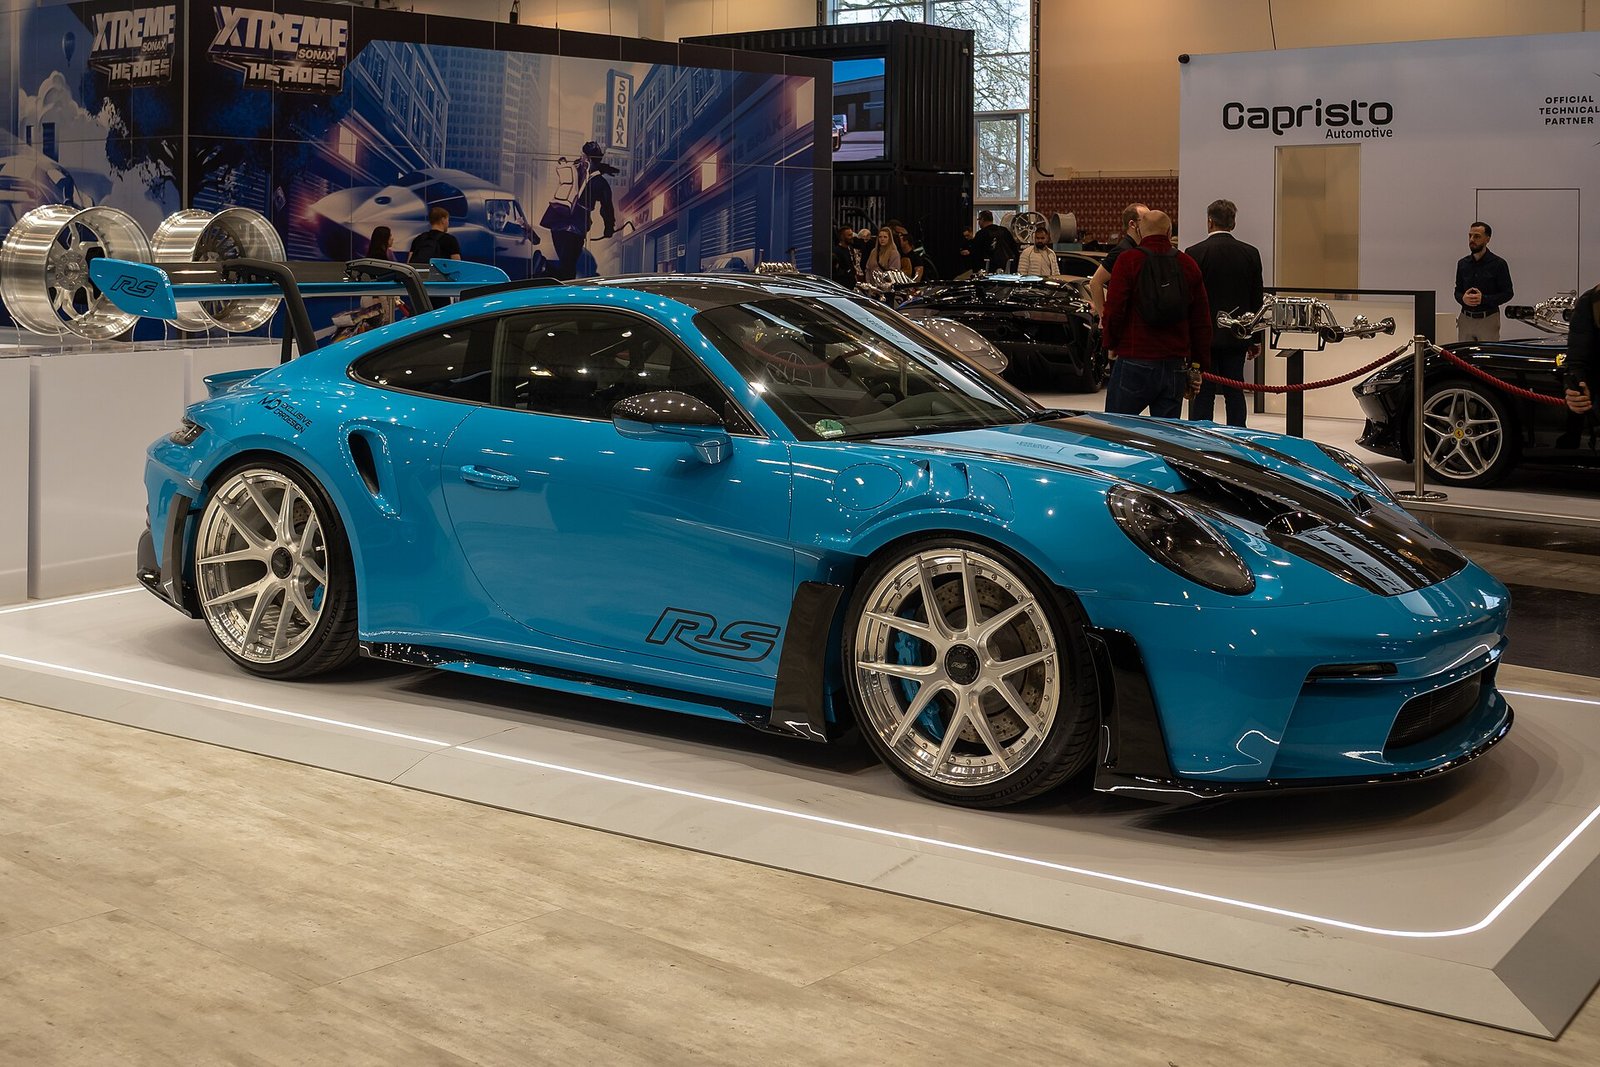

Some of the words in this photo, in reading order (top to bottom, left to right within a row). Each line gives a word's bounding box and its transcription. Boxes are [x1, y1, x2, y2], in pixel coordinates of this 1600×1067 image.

[92, 4, 176, 52] XTREME
[214, 5, 349, 57] XTREME
[142, 39, 167, 52] SONAX
[298, 49, 335, 61] SONAX
[108, 58, 170, 81] HEROES
[242, 61, 340, 88] HEROES
[1539, 106, 1600, 115] TECHNICAL
[1545, 95, 1594, 104] OFFICIAL
[616, 80, 627, 144] SONAX
[1222, 98, 1393, 136] Capristo
[1545, 116, 1594, 125] PARTNER
[1325, 127, 1393, 139] Automotive
[111, 274, 158, 298] RS
[646, 606, 781, 662] RS
